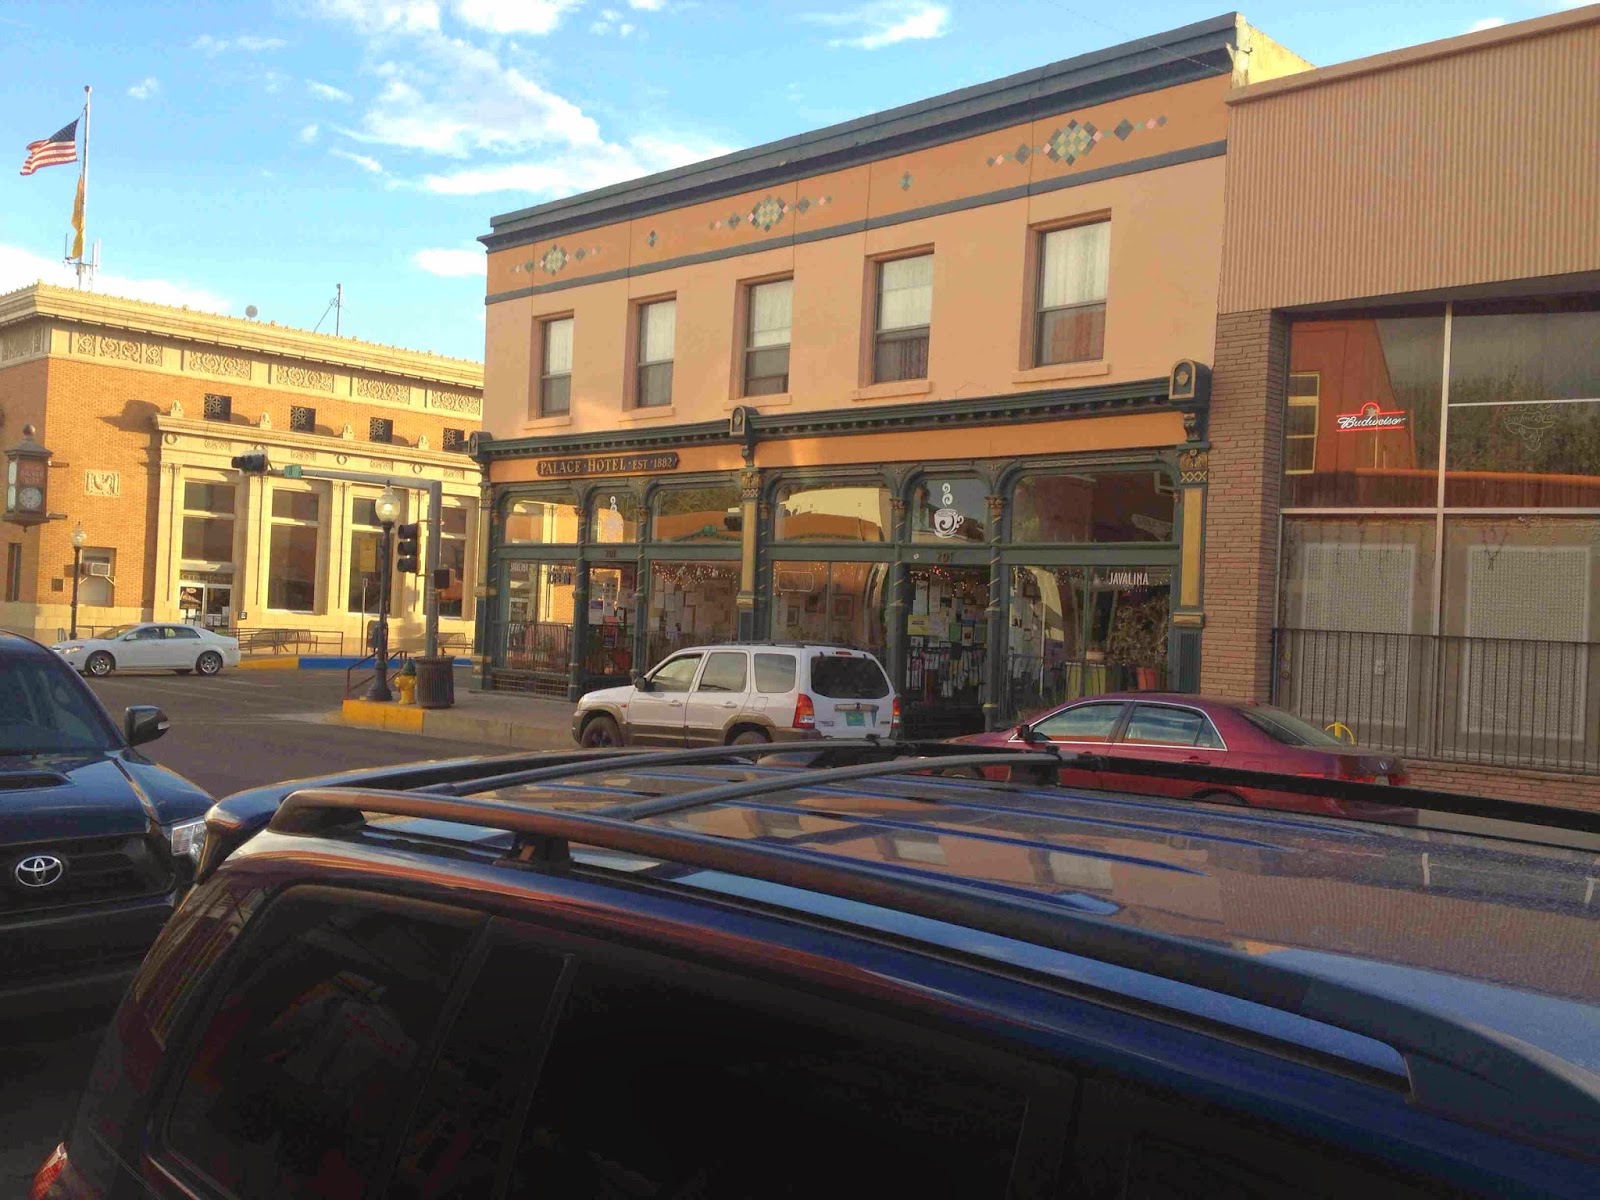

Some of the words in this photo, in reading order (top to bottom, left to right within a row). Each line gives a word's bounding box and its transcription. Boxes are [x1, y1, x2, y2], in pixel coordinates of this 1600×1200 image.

[1337, 415, 1406, 430] Budweiser
[540, 460, 581, 475] PALACE
[587, 458, 626, 472] HOTEL
[632, 459, 648, 470] EST
[653, 457, 673, 469] 1882
[1108, 572, 1149, 586] JAVALINA
